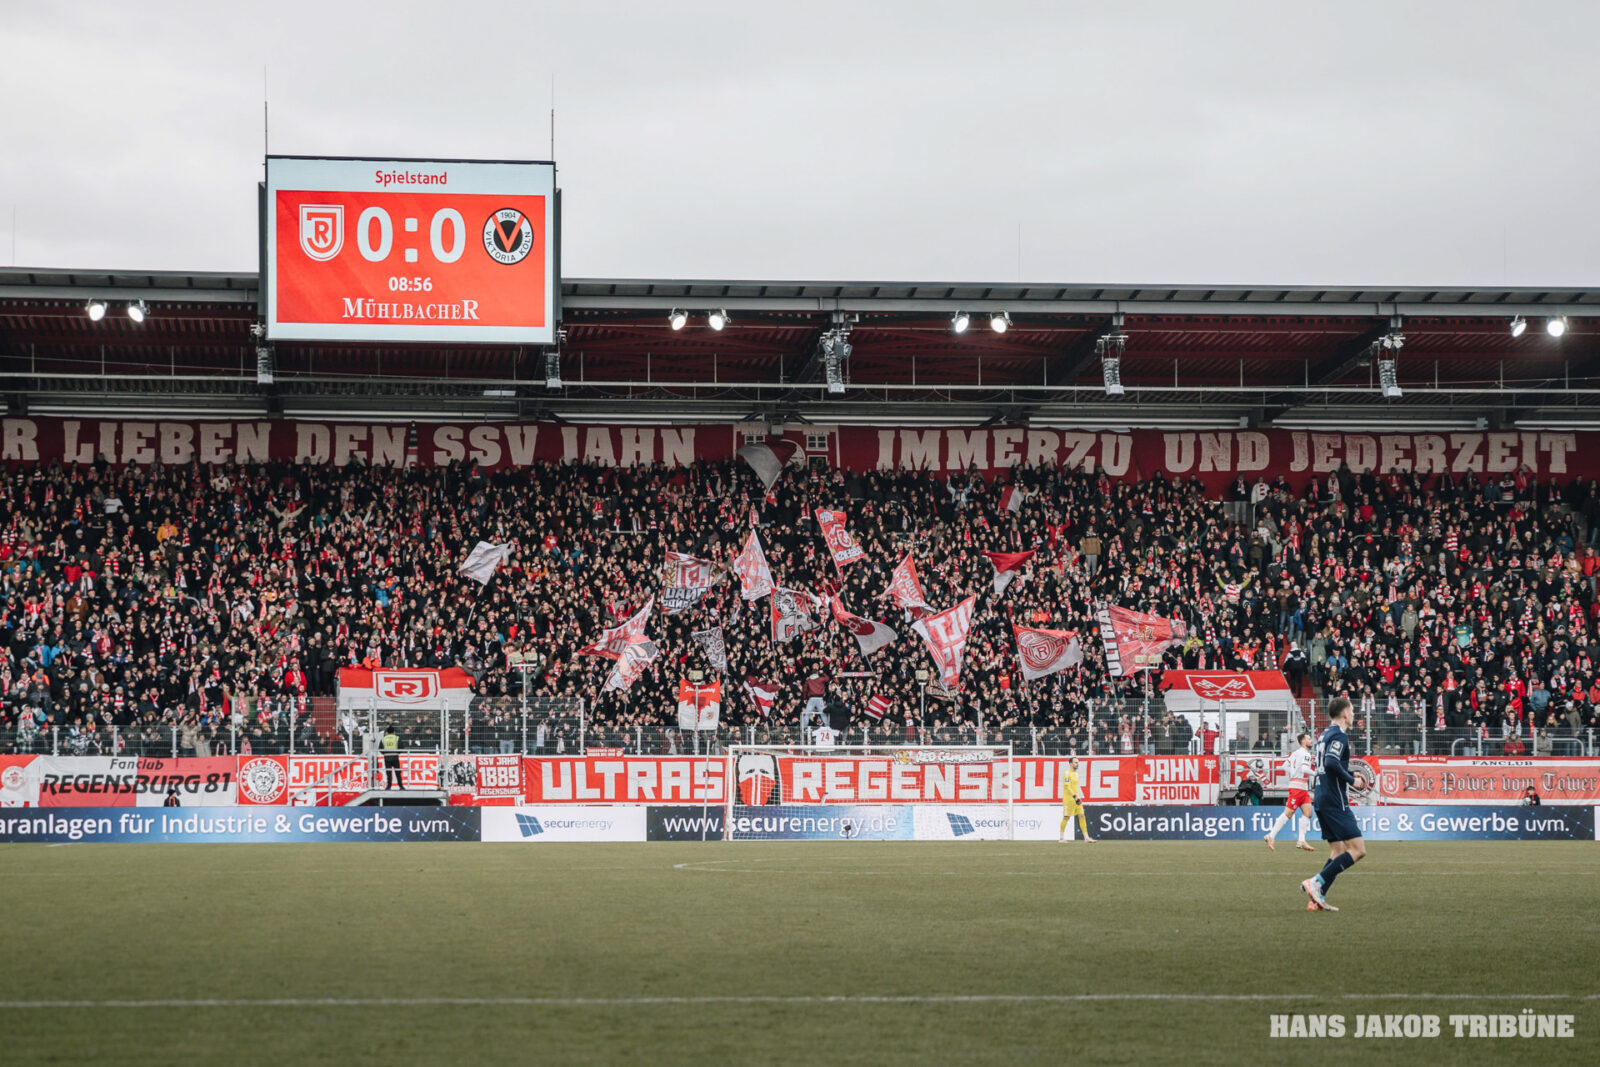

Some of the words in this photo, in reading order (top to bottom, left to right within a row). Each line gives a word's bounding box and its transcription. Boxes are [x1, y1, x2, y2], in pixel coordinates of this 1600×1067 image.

[375, 170, 447, 187] Spielstand
[357, 206, 466, 263] 0:0
[486, 230, 516, 262] VIKTORIA
[388, 276, 432, 292] 08:56
[63, 421, 271, 464] LIEBEN
[295, 424, 406, 467] DEN
[433, 425, 538, 467] SSV
[876, 428, 1133, 476] IMMERZU
[1163, 432, 1270, 473] UND
[1290, 431, 1576, 474] JEDERZEIT
[110, 758, 164, 770] Fanclub
[478, 757, 494, 765] SSV
[496, 756, 519, 765] JAHN
[1143, 758, 1198, 782] JAHN
[42, 774, 200, 796] REGENSBURG
[205, 773, 231, 793] 81
[479, 766, 520, 787] 1889
[541, 761, 724, 800] ULTRAS
[792, 760, 1120, 800] REGENSBURG
[1402, 771, 1434, 791] Die
[1440, 771, 1496, 795] Power
[1501, 774, 1535, 791] vom
[1542, 772, 1597, 791] Tower
[480, 787, 521, 795] REGENSBURG
[1143, 785, 1199, 801] STADION
[119, 813, 154, 834] für
[162, 813, 266, 834] Industrie
[274, 814, 291, 834] &
[299, 813, 402, 834] Gewerbe
[409, 819, 455, 833] uvm.
[544, 819, 613, 830] securenergy
[1100, 813, 1245, 838] Solaranlagen
[1251, 812, 1281, 832] fü
[1397, 813, 1414, 832] &
[1420, 813, 1519, 832] Gewerbe
[1525, 817, 1570, 832] uvm.
